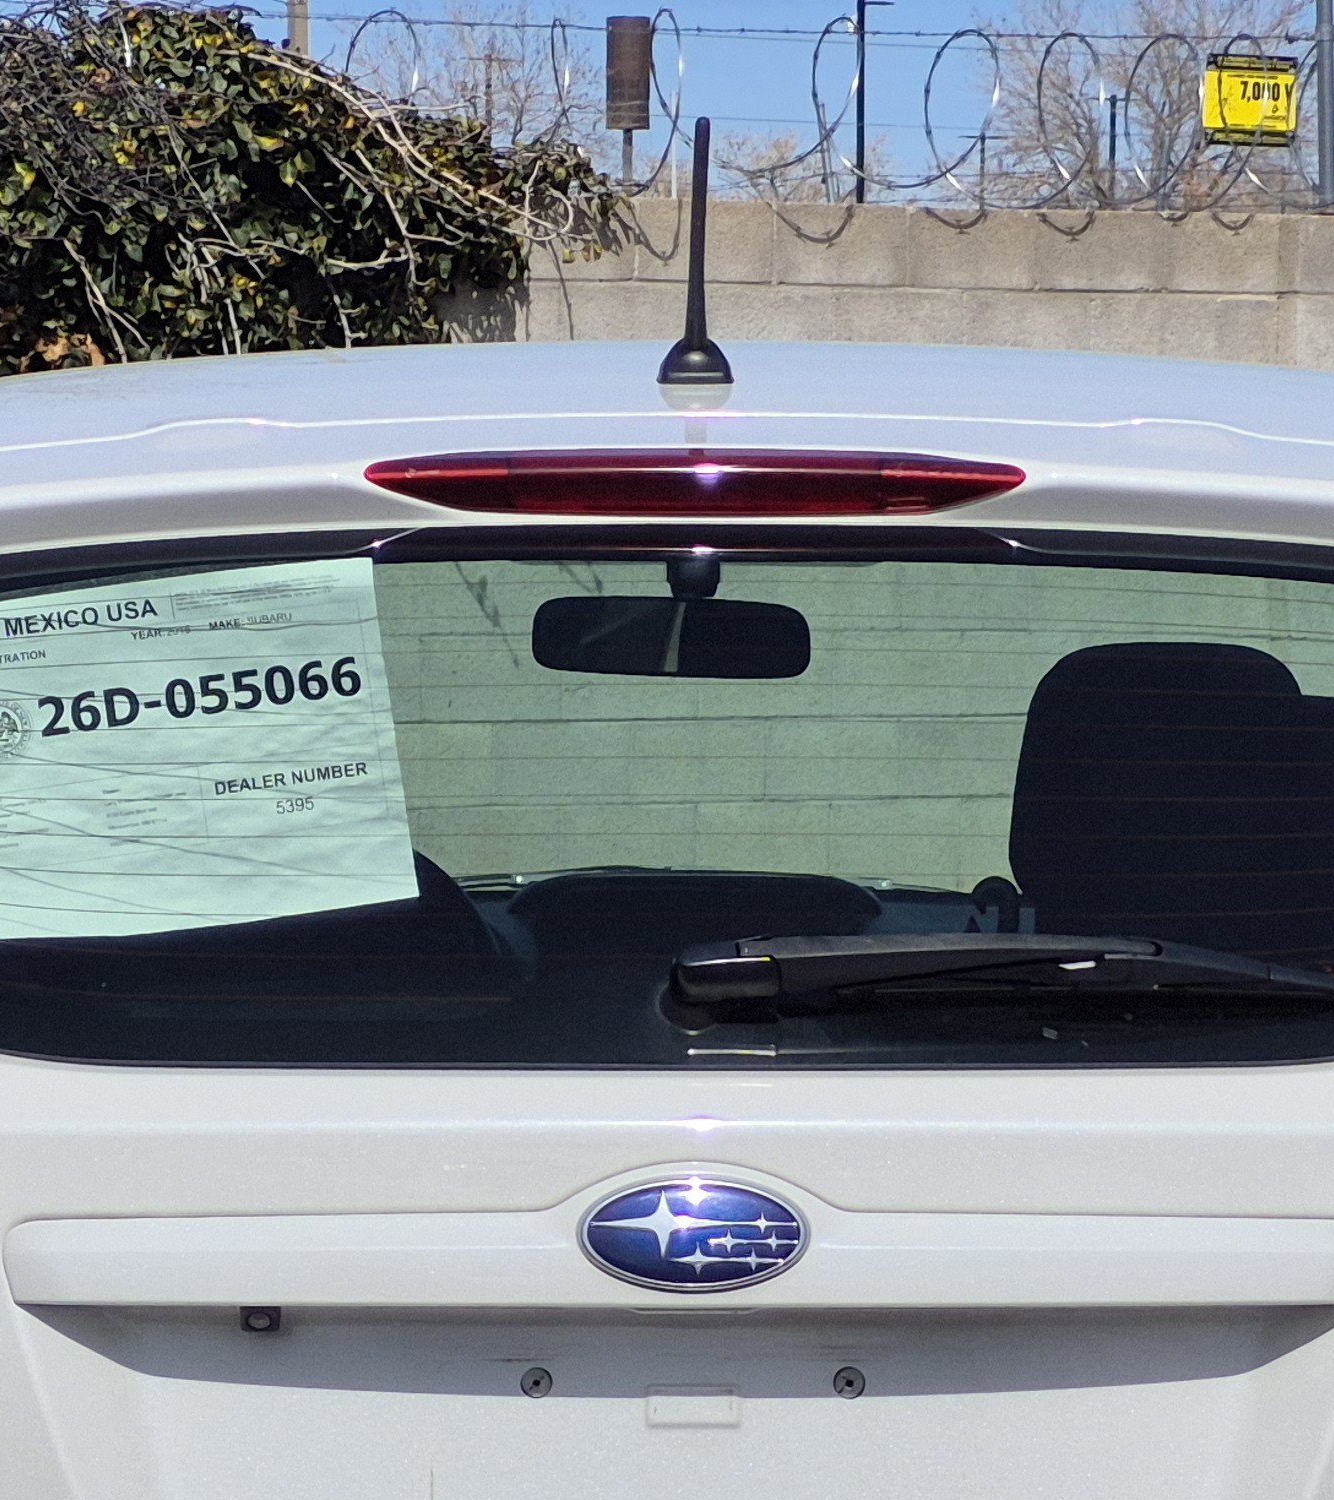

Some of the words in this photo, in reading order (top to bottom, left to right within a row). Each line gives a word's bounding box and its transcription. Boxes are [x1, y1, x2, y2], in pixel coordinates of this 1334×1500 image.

[4, 607, 99, 638] MEXICO
[106, 599, 158, 622] USA
[37, 656, 363, 737] 26D-055066
[214, 771, 287, 796] DEALER
[291, 762, 369, 786] NUMBER
[275, 796, 315, 816] 5395
